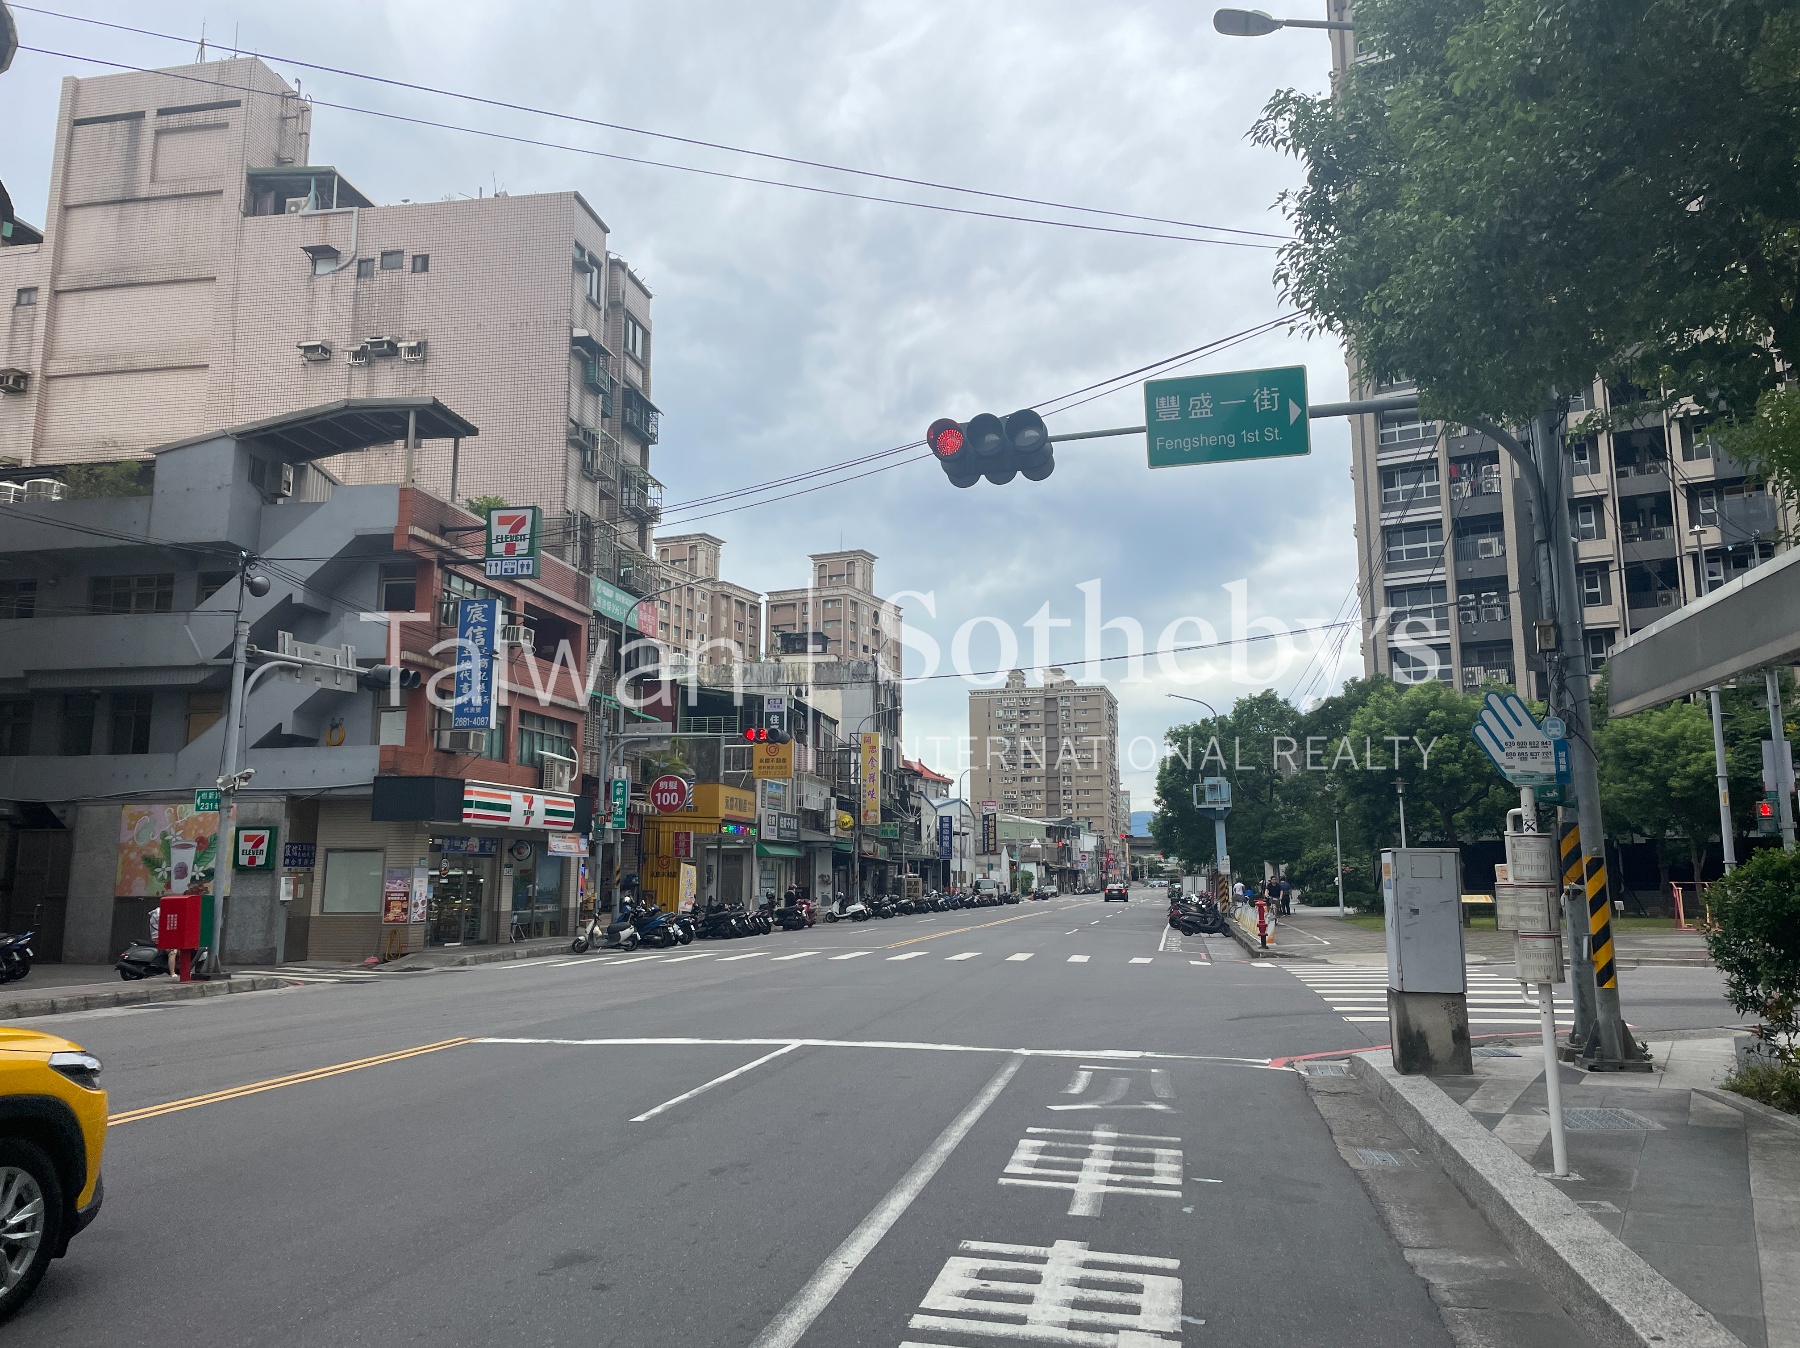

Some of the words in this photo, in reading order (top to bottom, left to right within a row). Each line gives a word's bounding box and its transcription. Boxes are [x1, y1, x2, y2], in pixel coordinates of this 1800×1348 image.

[1155, 386, 1280, 422] 豐盛一街
[1156, 433, 1236, 452] Fengsheng
[1240, 429, 1260, 444] 1st
[1264, 427, 1283, 442] St.
[497, 515, 527, 555] 7
[465, 602, 489, 646] 宸信
[454, 716, 490, 727] 2681-4087
[658, 780, 678, 790] 剪髮
[616, 788, 624, 815] 新樹路
[655, 792, 679, 806] 100
[725, 795, 748, 813] 永慶不動產
[243, 834, 266, 866] 7
